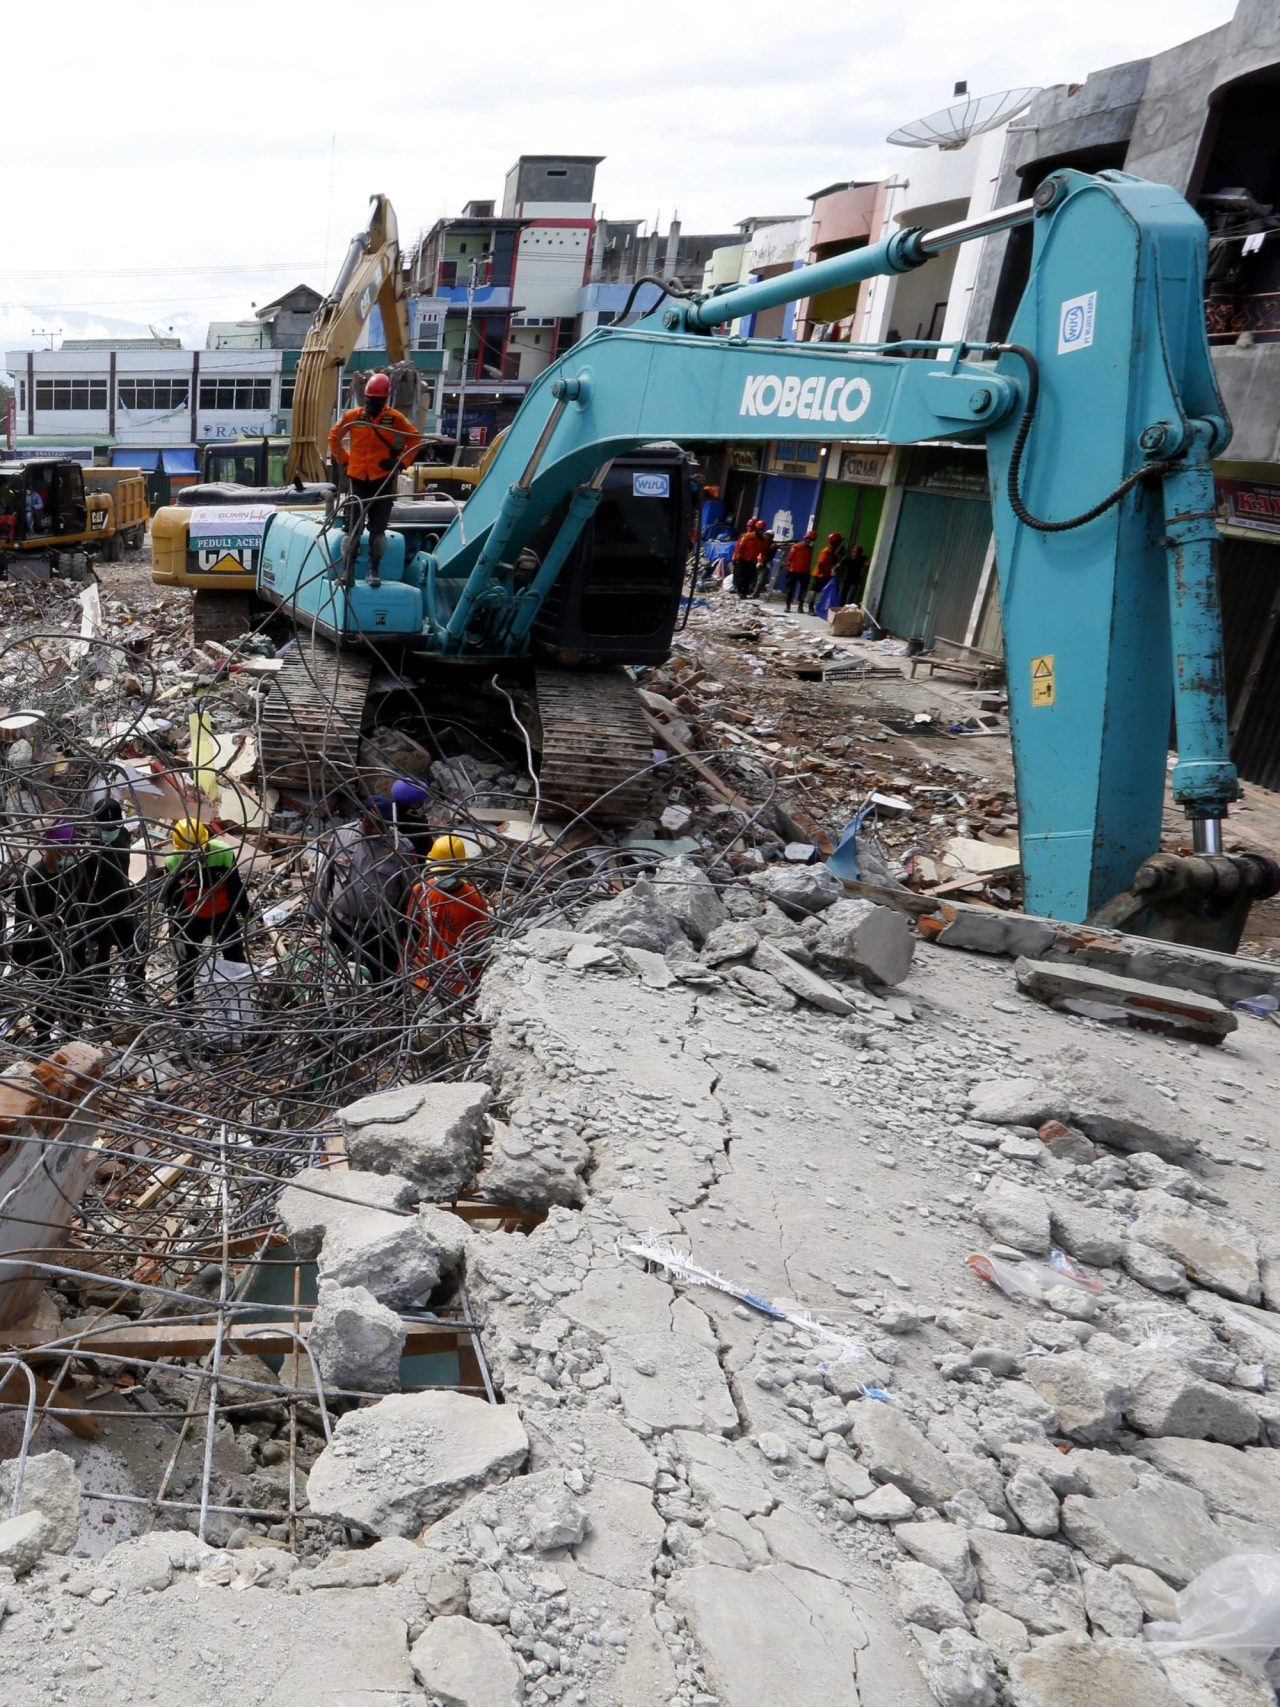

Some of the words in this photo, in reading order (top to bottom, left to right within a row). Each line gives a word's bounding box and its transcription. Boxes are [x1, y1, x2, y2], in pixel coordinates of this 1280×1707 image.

[739, 375, 871, 422] KOBELCO
[198, 539, 232, 548] PEDULI
[236, 538, 262, 547] ACEH
